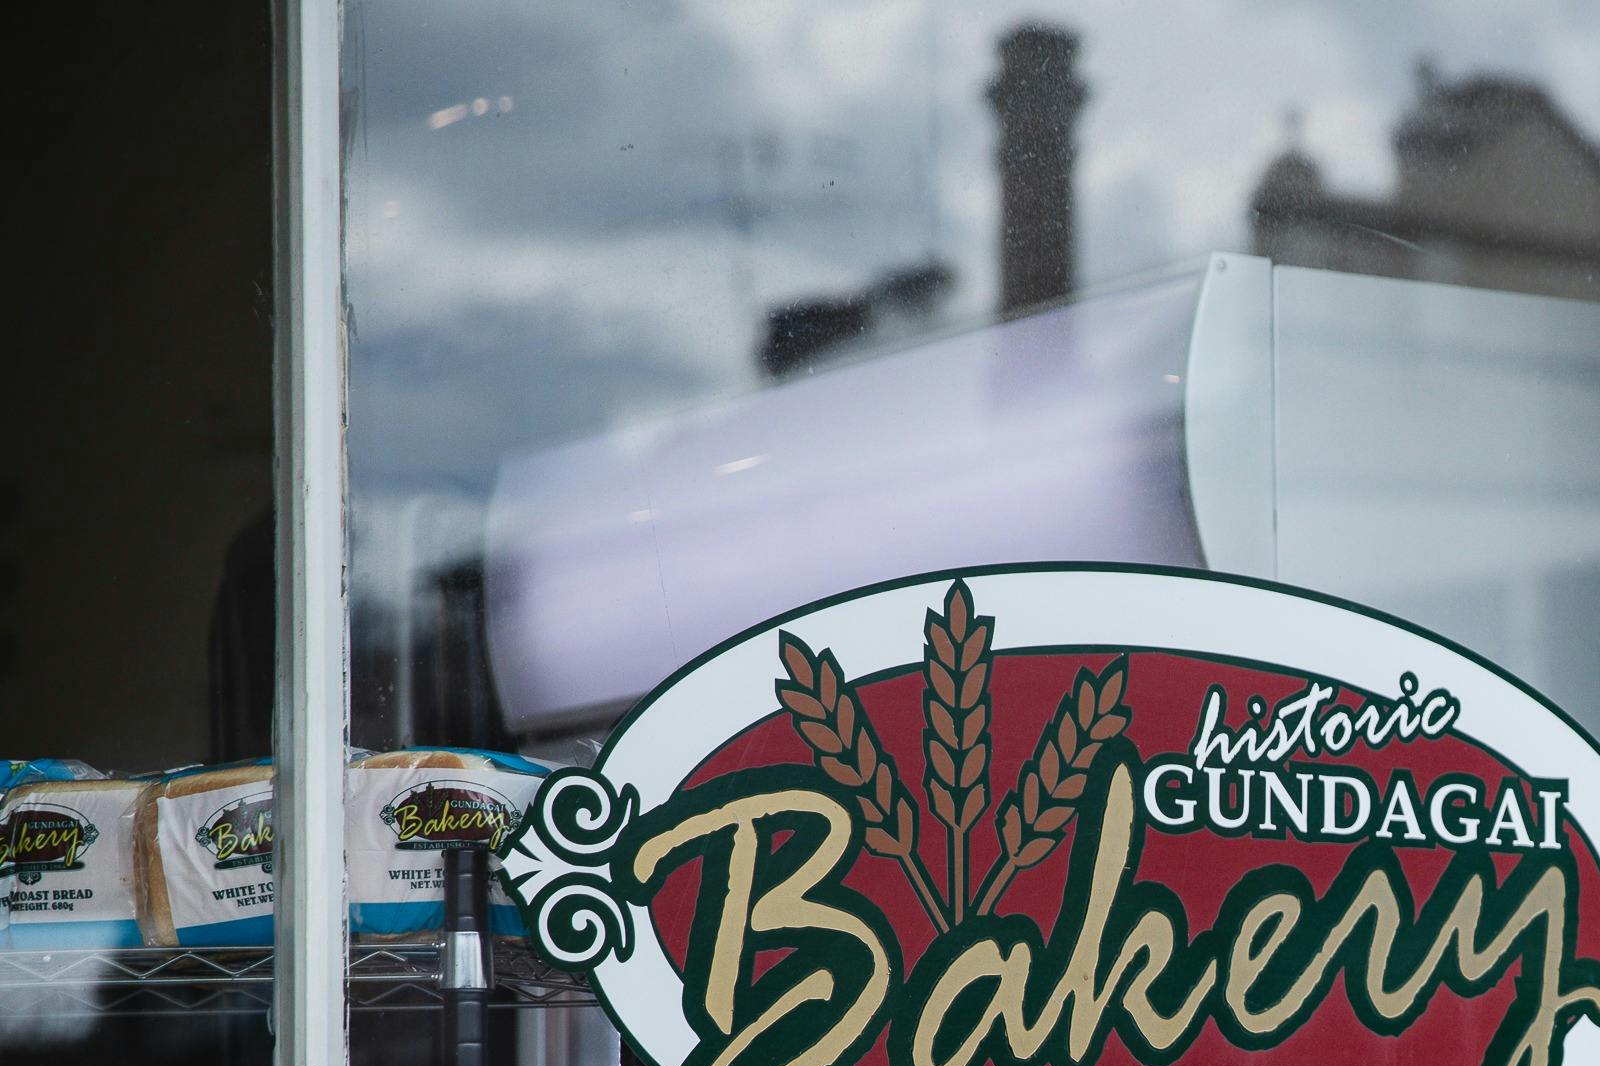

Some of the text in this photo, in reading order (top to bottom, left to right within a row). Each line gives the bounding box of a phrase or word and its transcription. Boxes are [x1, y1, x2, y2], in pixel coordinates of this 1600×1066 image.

[1193, 671, 1459, 770] historic
[451, 800, 505, 812] GUNDAGAI
[1143, 763, 1564, 850] GUNDAGAI
[209, 812, 274, 859] Bak
[394, 800, 510, 850] Bakery
[0, 822, 85, 867] kery
[388, 869, 431, 880] WHITE
[52, 902, 73, 911] 680g
[53, 889, 93, 899] BREAD
[212, 884, 255, 900] WHITE
